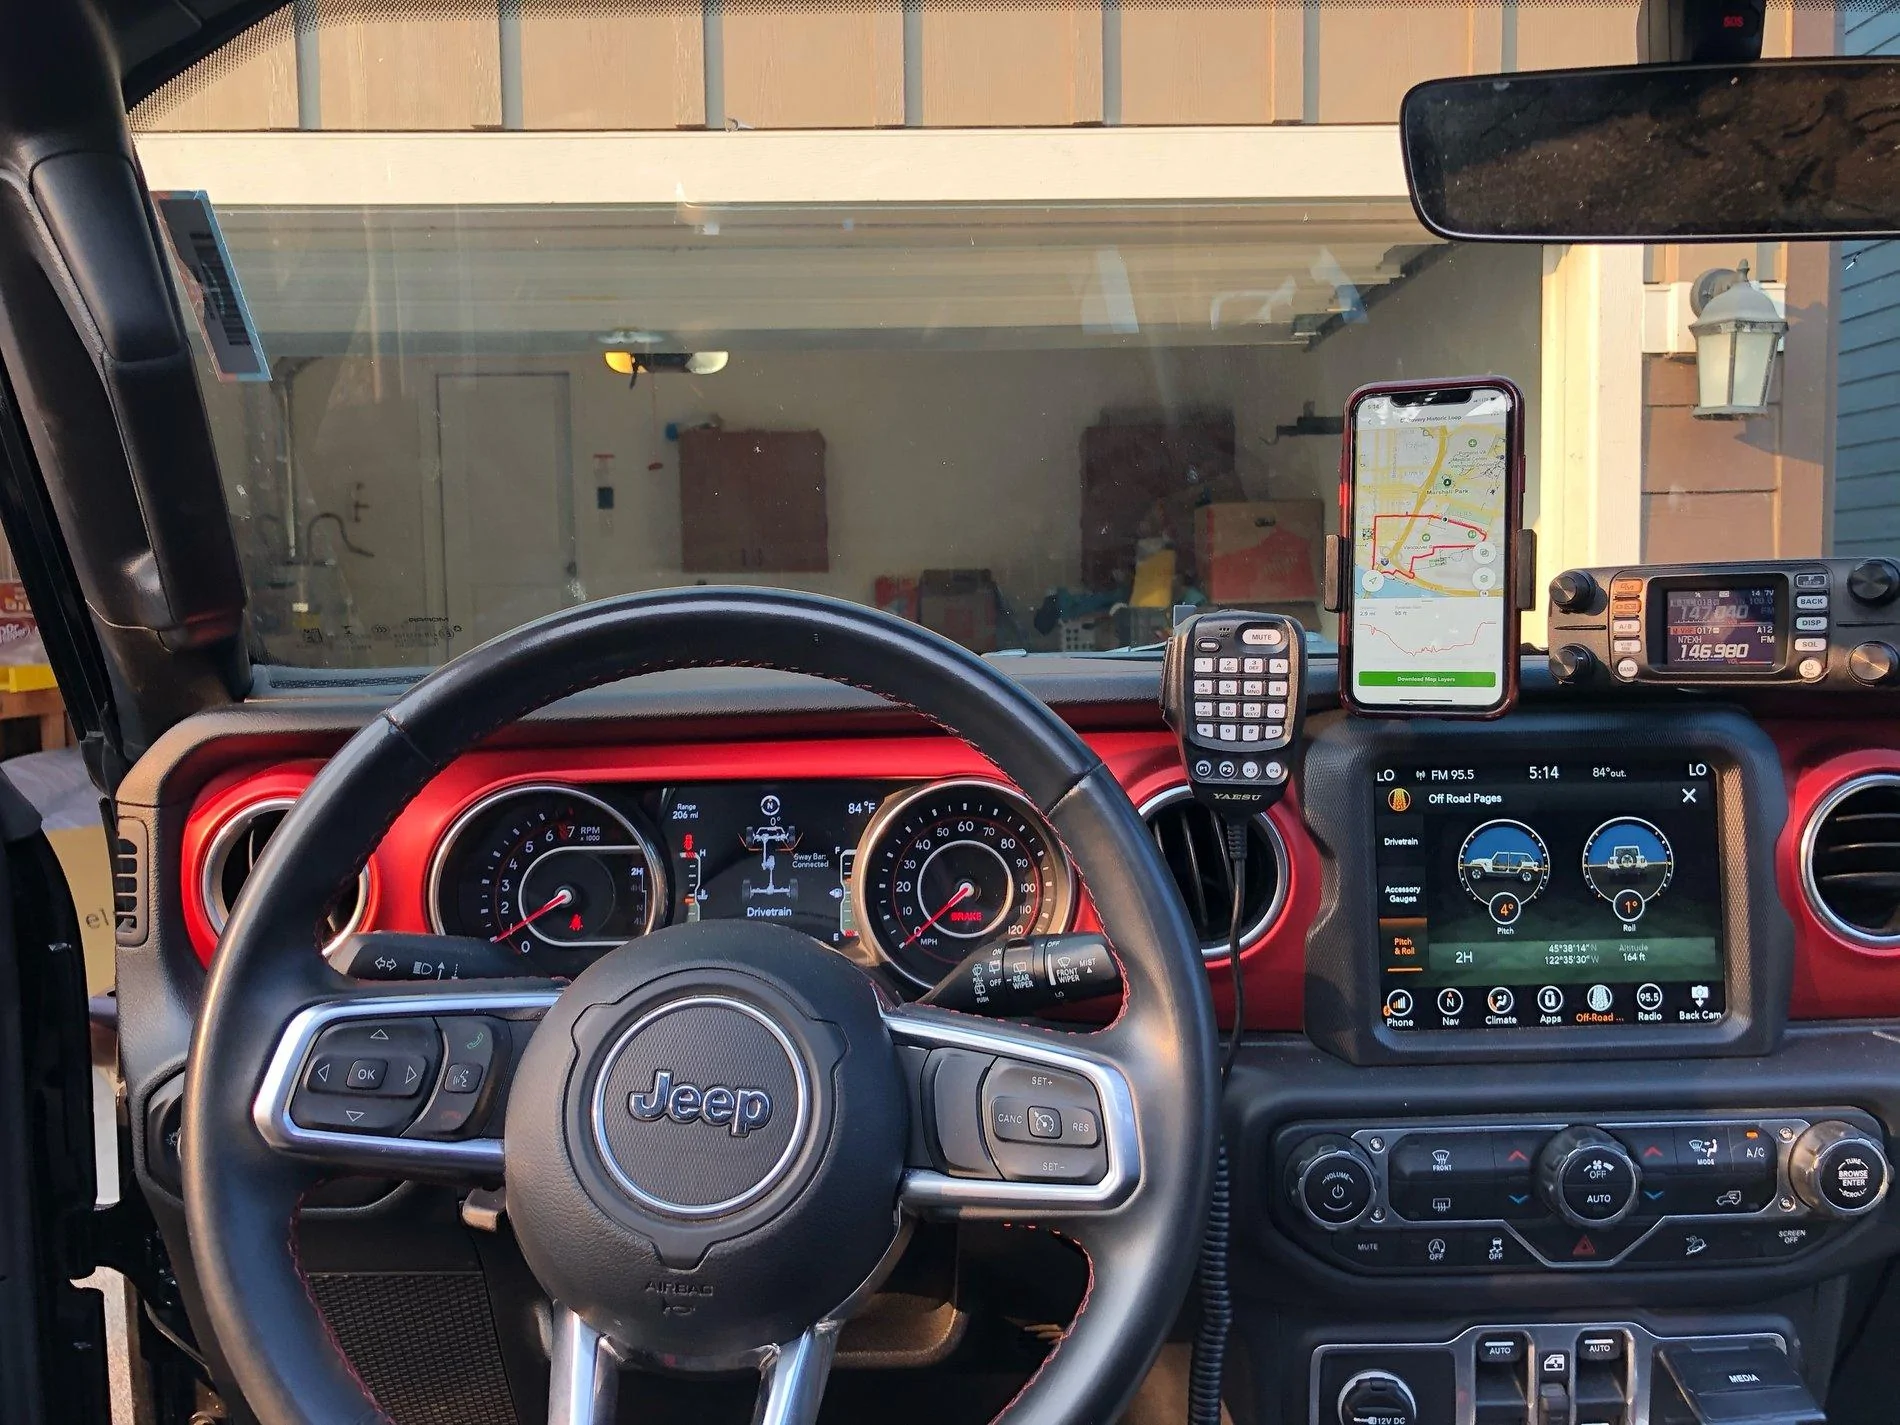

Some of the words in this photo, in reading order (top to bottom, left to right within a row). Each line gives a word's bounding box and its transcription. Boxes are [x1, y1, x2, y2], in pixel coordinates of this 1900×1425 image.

[1723, 16, 1744, 27] SOS
[1756, 626, 1773, 634] A12
[1680, 643, 1749, 659] 146.980
[1424, 676, 1437, 684] Map
[1437, 676, 1456, 684] Layers
[1376, 768, 1395, 782] LO
[1431, 770, 1449, 780] FM
[1450, 769, 1475, 780] 95.5
[1529, 766, 1560, 780] 5:14
[1688, 763, 1707, 777] LO
[1213, 792, 1262, 801] YAESU
[1428, 793, 1444, 804] Off
[1446, 793, 1471, 804] Road
[1473, 793, 1502, 805] Pages
[672, 811, 688, 819] 206
[580, 826, 600, 834] RPM
[957, 821, 974, 832] 60
[983, 827, 995, 836] 70
[545, 830, 554, 841] 6
[566, 826, 576, 838] 7
[936, 827, 950, 837] 50
[525, 841, 534, 853] 5
[915, 839, 931, 851] 40
[1000, 838, 1016, 849] 80
[1384, 837, 1419, 847] Drivetrain
[812, 853, 827, 861] Bar:
[509, 858, 518, 870] 4
[792, 860, 829, 868] Connected
[903, 860, 917, 869] 30
[1016, 858, 1029, 868] 90
[630, 867, 644, 876] 2H
[501, 879, 510, 891] 3
[895, 881, 911, 892] 20
[1020, 883, 1036, 893] 100
[1384, 885, 1421, 895] Accessory
[1389, 894, 1417, 904] Gauges
[500, 901, 509, 914] 2
[747, 907, 792, 917] Drivetrain
[902, 906, 913, 916] 10
[1019, 905, 1032, 915] 110
[950, 912, 983, 921] BRAKE
[1007, 925, 1024, 935] 120
[1496, 926, 1515, 936] Pitch
[1622, 923, 1637, 932] Roll
[920, 938, 938, 946] MPH
[1047, 940, 1061, 948] OFF
[1393, 937, 1413, 946] Pitch
[521, 941, 531, 953] 0
[992, 947, 1002, 956] ON
[1394, 946, 1401, 955] &
[1401, 946, 1416, 956] Roll
[1455, 951, 1473, 964] 2H
[1622, 952, 1638, 962] 164
[1638, 952, 1646, 962] ft
[1079, 957, 1097, 968] MIST
[1056, 967, 1078, 977] FRONT
[989, 978, 1002, 987] OFF
[1012, 973, 1030, 982] REAR
[1057, 974, 1081, 984] WIPER
[1012, 980, 1034, 990] WIPER
[1639, 992, 1660, 1002] 95.5
[1539, 1014, 1562, 1024] Apps
[1575, 1012, 1614, 1022] Off-Road
[1638, 1011, 1663, 1021] Radio
[1679, 1011, 1700, 1020] Back
[1701, 1010, 1723, 1020] Cam
[1386, 1017, 1414, 1027] Phone
[1442, 1016, 1460, 1026] Nav
[1485, 1015, 1518, 1026] Climate
[357, 1068, 377, 1081] OK
[628, 1068, 774, 1138] Jeep
[997, 1113, 1023, 1124] CANC
[1072, 1122, 1090, 1132] RES
[1746, 1146, 1766, 1158] A/C
[1697, 1158, 1715, 1166] MODE
[1844, 1157, 1862, 1166] TUNE
[1325, 1172, 1351, 1181] VOLUME
[1589, 1170, 1607, 1179] OFF
[1837, 1169, 1868, 1178] BROWSE
[1842, 1178, 1866, 1187] ENTER
[1841, 1188, 1866, 1198] SCROLL
[1587, 1194, 1611, 1203] AUTO
[1778, 1229, 1806, 1238] SCREEN
[1783, 1236, 1799, 1244] OFF
[1357, 1243, 1379, 1251] MUTE
[1429, 1253, 1444, 1261] OFF
[1488, 1253, 1504, 1261] OFF
[645, 1281, 714, 1297] AIRBAG
[1489, 1346, 1511, 1355] AUTO
[1589, 1344, 1611, 1353] AUTO
[1728, 1374, 1761, 1383] MEDIA
[1376, 1417, 1392, 1425] 12V
[1393, 1417, 1406, 1425] DC
